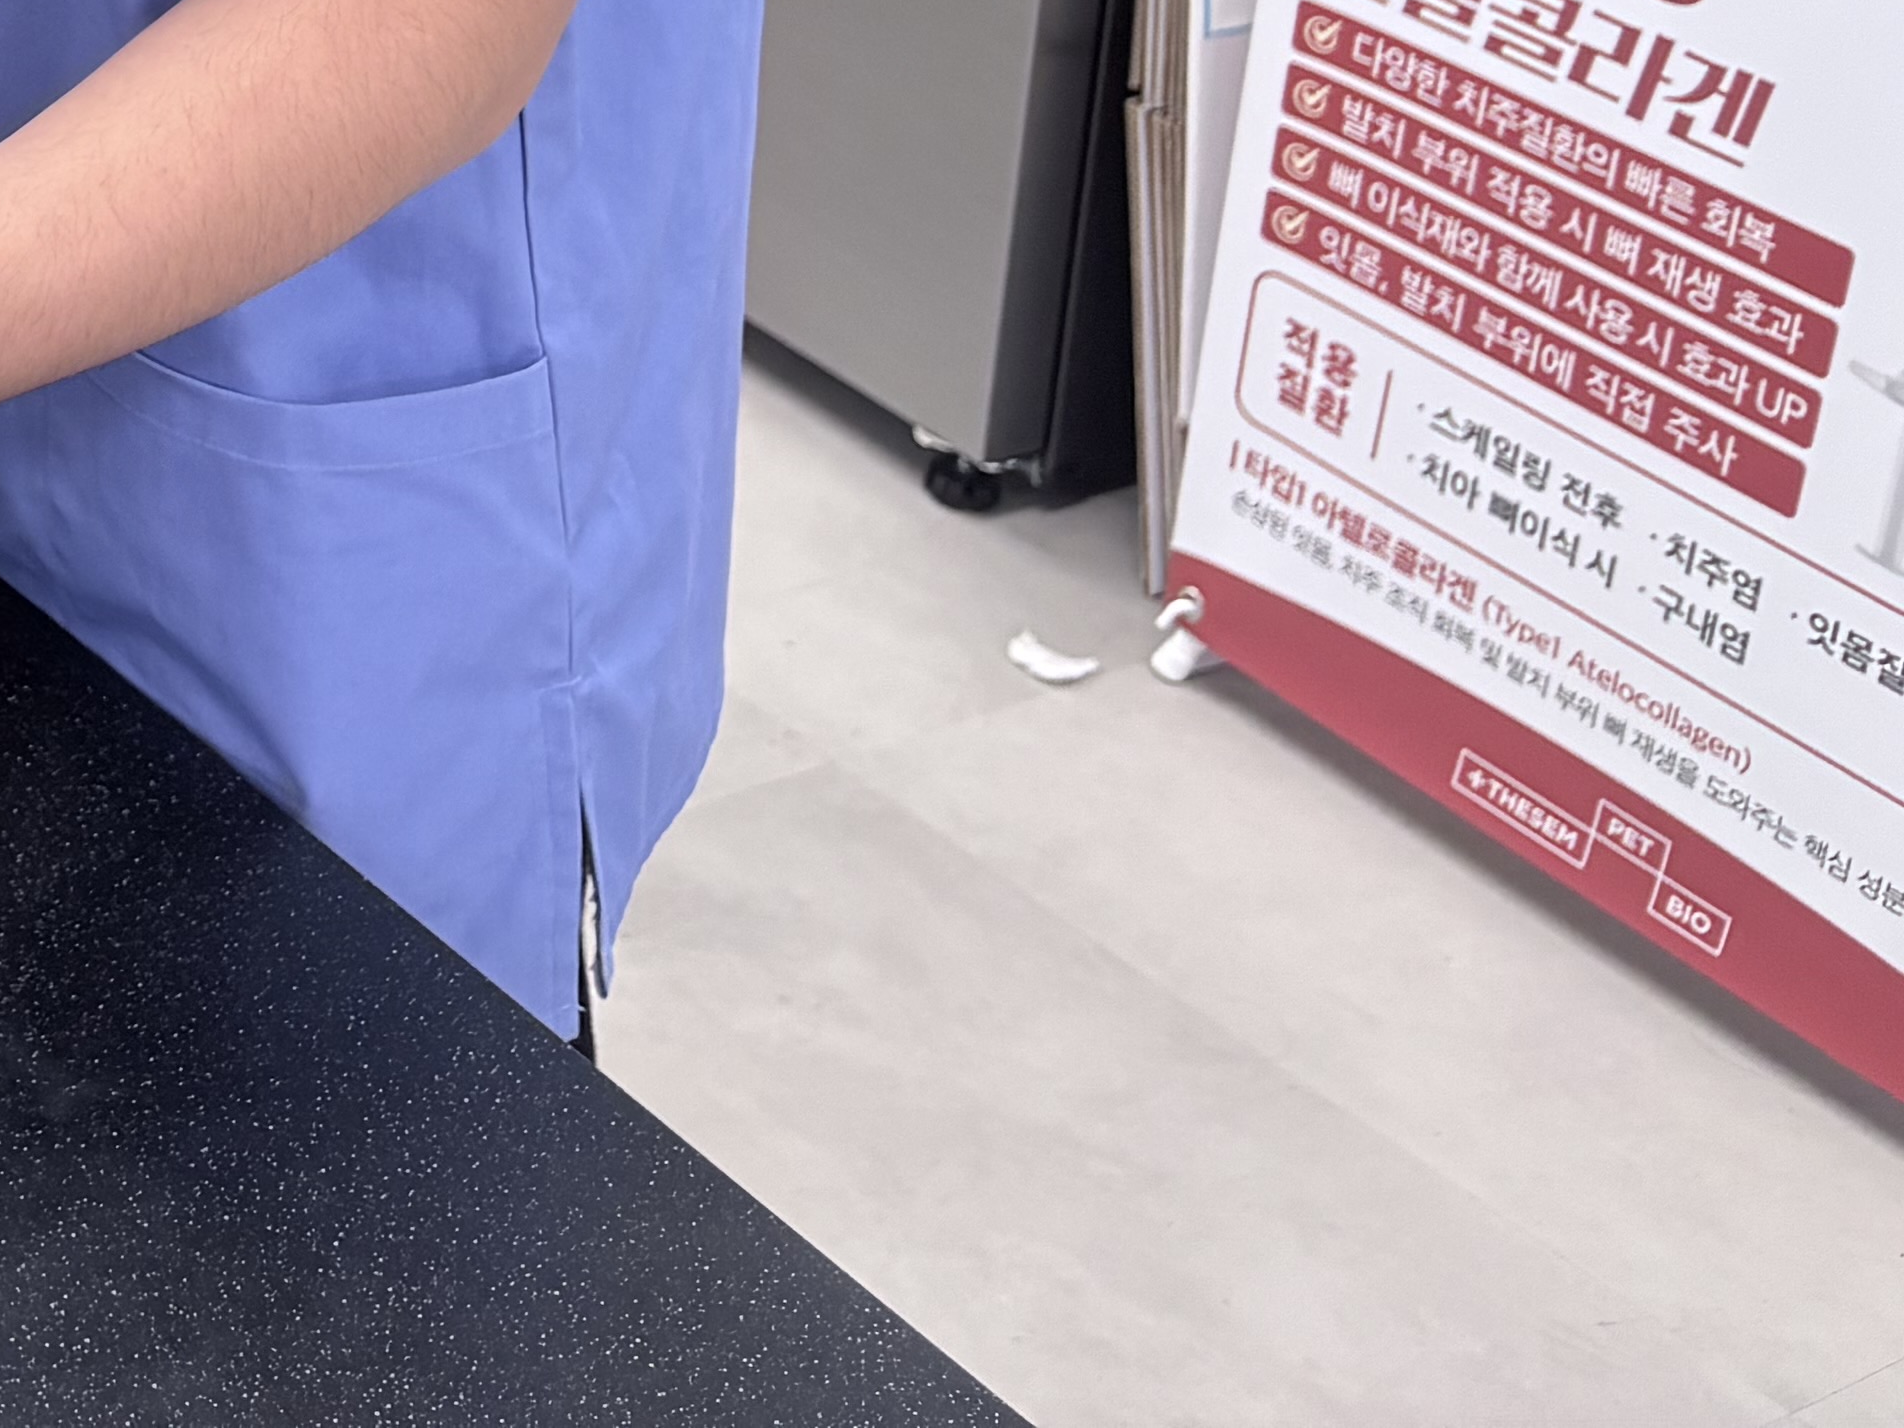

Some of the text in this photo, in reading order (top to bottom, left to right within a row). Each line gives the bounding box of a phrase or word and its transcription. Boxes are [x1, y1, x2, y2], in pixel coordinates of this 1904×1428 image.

[1352, 32, 1776, 265] 다양한 치주질환의 빠른 회복
[1341, 95, 1805, 356] 발치 부위 적용 시 뼈 재생 효과
[1318, 225, 1739, 477] 잇몸, 발치 부위에 직접 주사
[1497, 244, 1564, 312] 함께
[1564, 285, 1635, 345] 사용
[1636, 322, 1674, 368] 시
[1676, 340, 1751, 406] 효과
[1755, 377, 1809, 424] UP
[1277, 361, 1350, 438] 질환
[1421, 453, 1481, 511] 치아
[1585, 549, 1618, 590] 시
[1429, 407, 1624, 530] 스케일링 전후
[1311, 491, 1478, 613] 아텔로콜라겐
[1482, 595, 1562, 660] (Type1
[1568, 649, 1752, 775] Atelocollagen)
[1652, 583, 1751, 666] 구내염
[1663, 532, 1763, 612] 치주염
[1606, 817, 1655, 857] PET
[1703, 773, 1799, 850] 도와주는
[1804, 833, 1853, 884] 핵심
[1664, 894, 1712, 935] BIO
